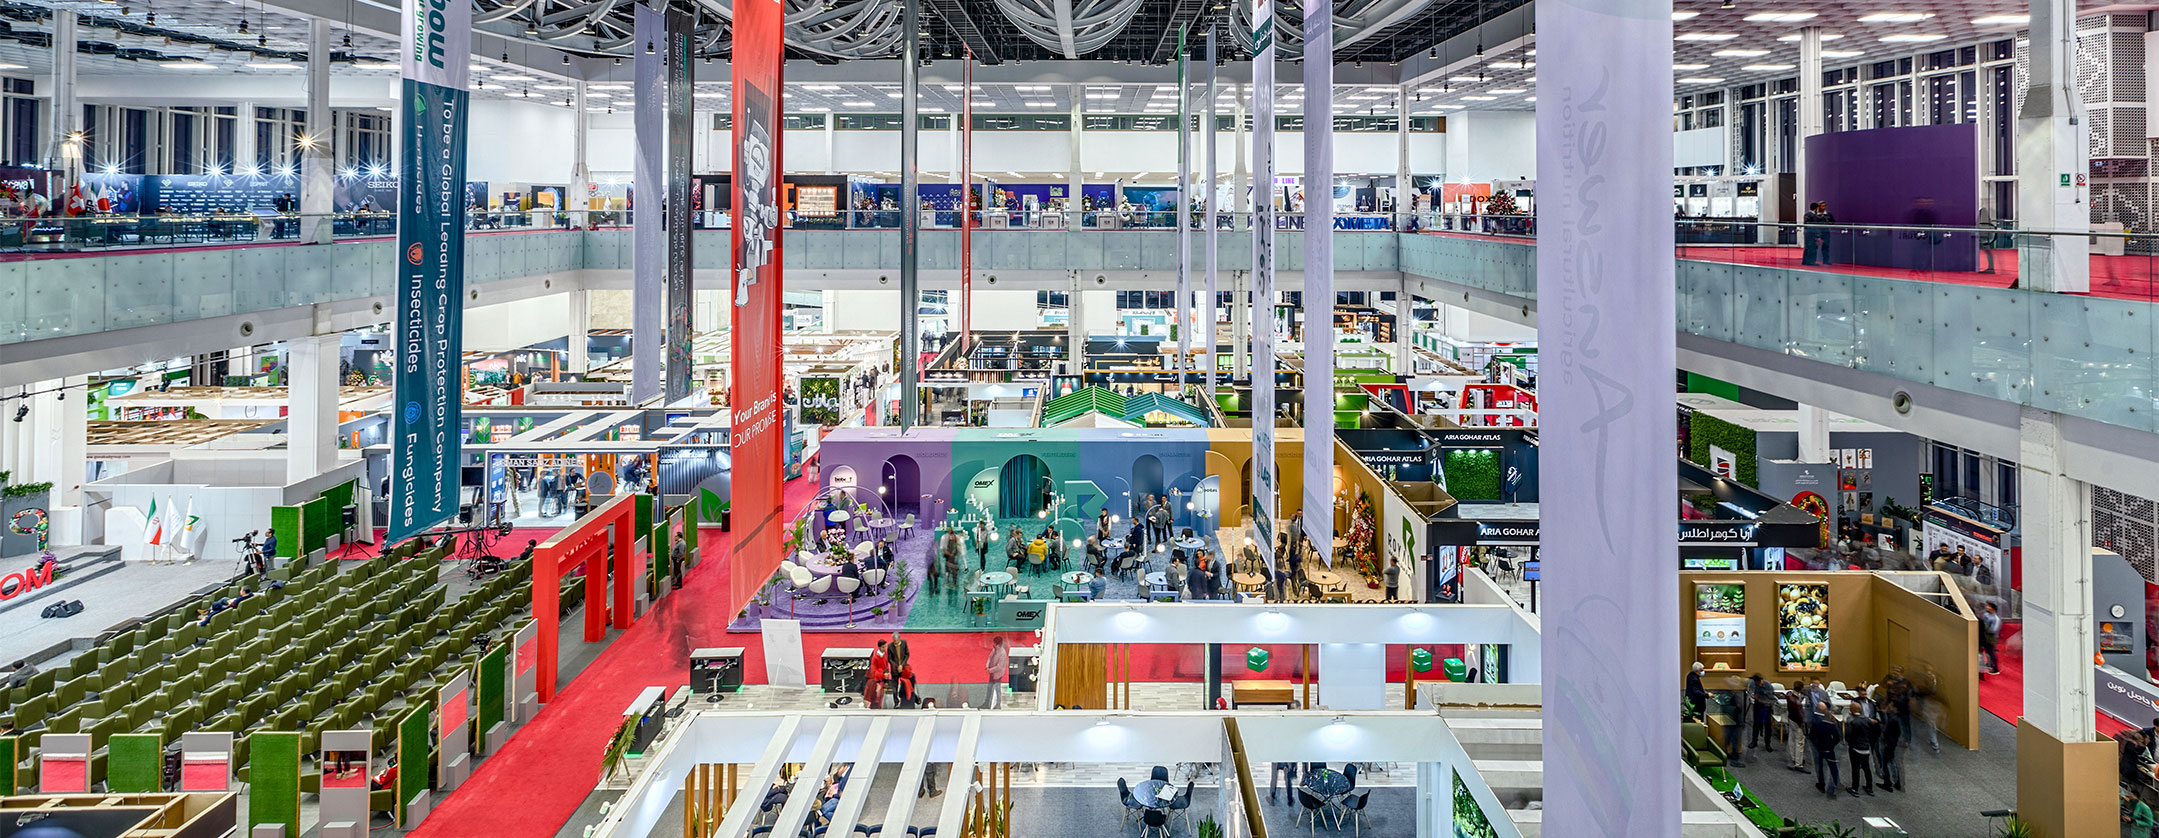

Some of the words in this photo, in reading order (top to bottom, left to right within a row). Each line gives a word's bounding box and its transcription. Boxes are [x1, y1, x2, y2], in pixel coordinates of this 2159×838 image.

[415, 8, 425, 62] growing
[443, 99, 454, 120] To
[442, 123, 453, 145] be
[442, 148, 450, 159] a
[441, 164, 452, 218] Global
[435, 222, 450, 290] Leading
[407, 274, 424, 373] Insecticides
[435, 293, 448, 335] Crop
[436, 339, 448, 428] Protection
[734, 409, 752, 426] Your
[753, 399, 770, 416] Bran
[432, 431, 445, 513] Company
[1376, 455, 1401, 463] GOHAR
[1401, 455, 1422, 463] ATLAS
[402, 433, 417, 528] Fungicides
[1480, 528, 1501, 536] ARIA
[1502, 528, 1534, 536] GOHAR
[1016, 609, 1042, 620] OMEX
